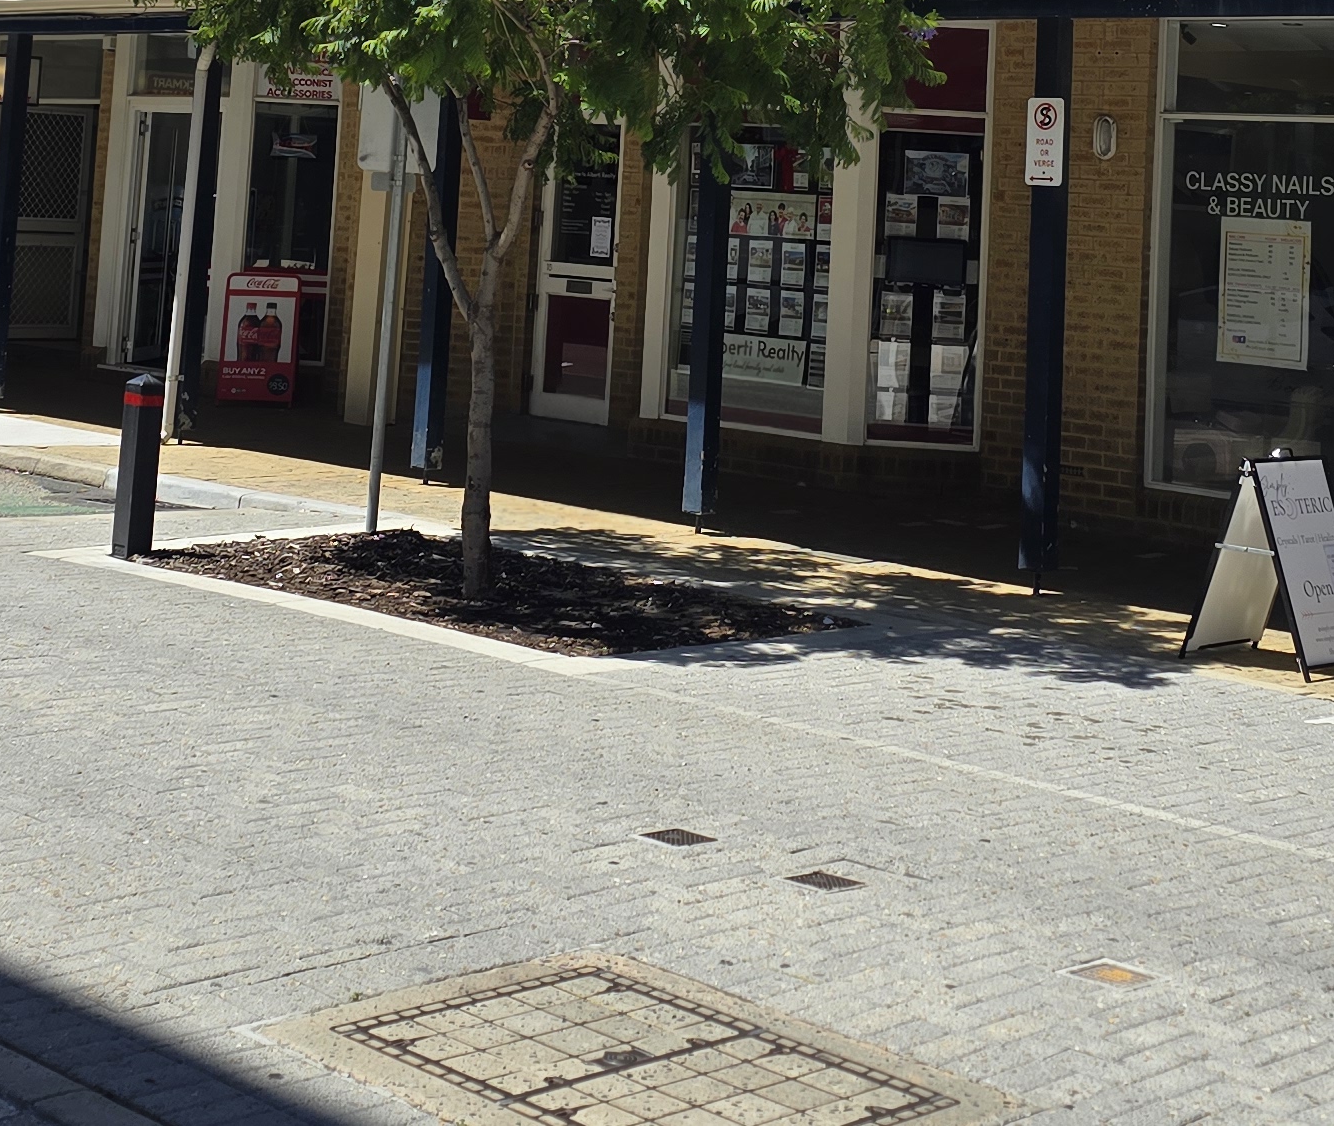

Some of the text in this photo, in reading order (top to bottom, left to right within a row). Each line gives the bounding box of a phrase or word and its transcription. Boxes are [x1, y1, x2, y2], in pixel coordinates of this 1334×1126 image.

[267, 88, 333, 99] ACCSSORIES
[1185, 171, 1334, 196] CLASSY NAILS
[1207, 197, 1310, 219] & BEAUTY
[757, 340, 804, 367] Realty
[1303, 580, 1334, 603] Open
